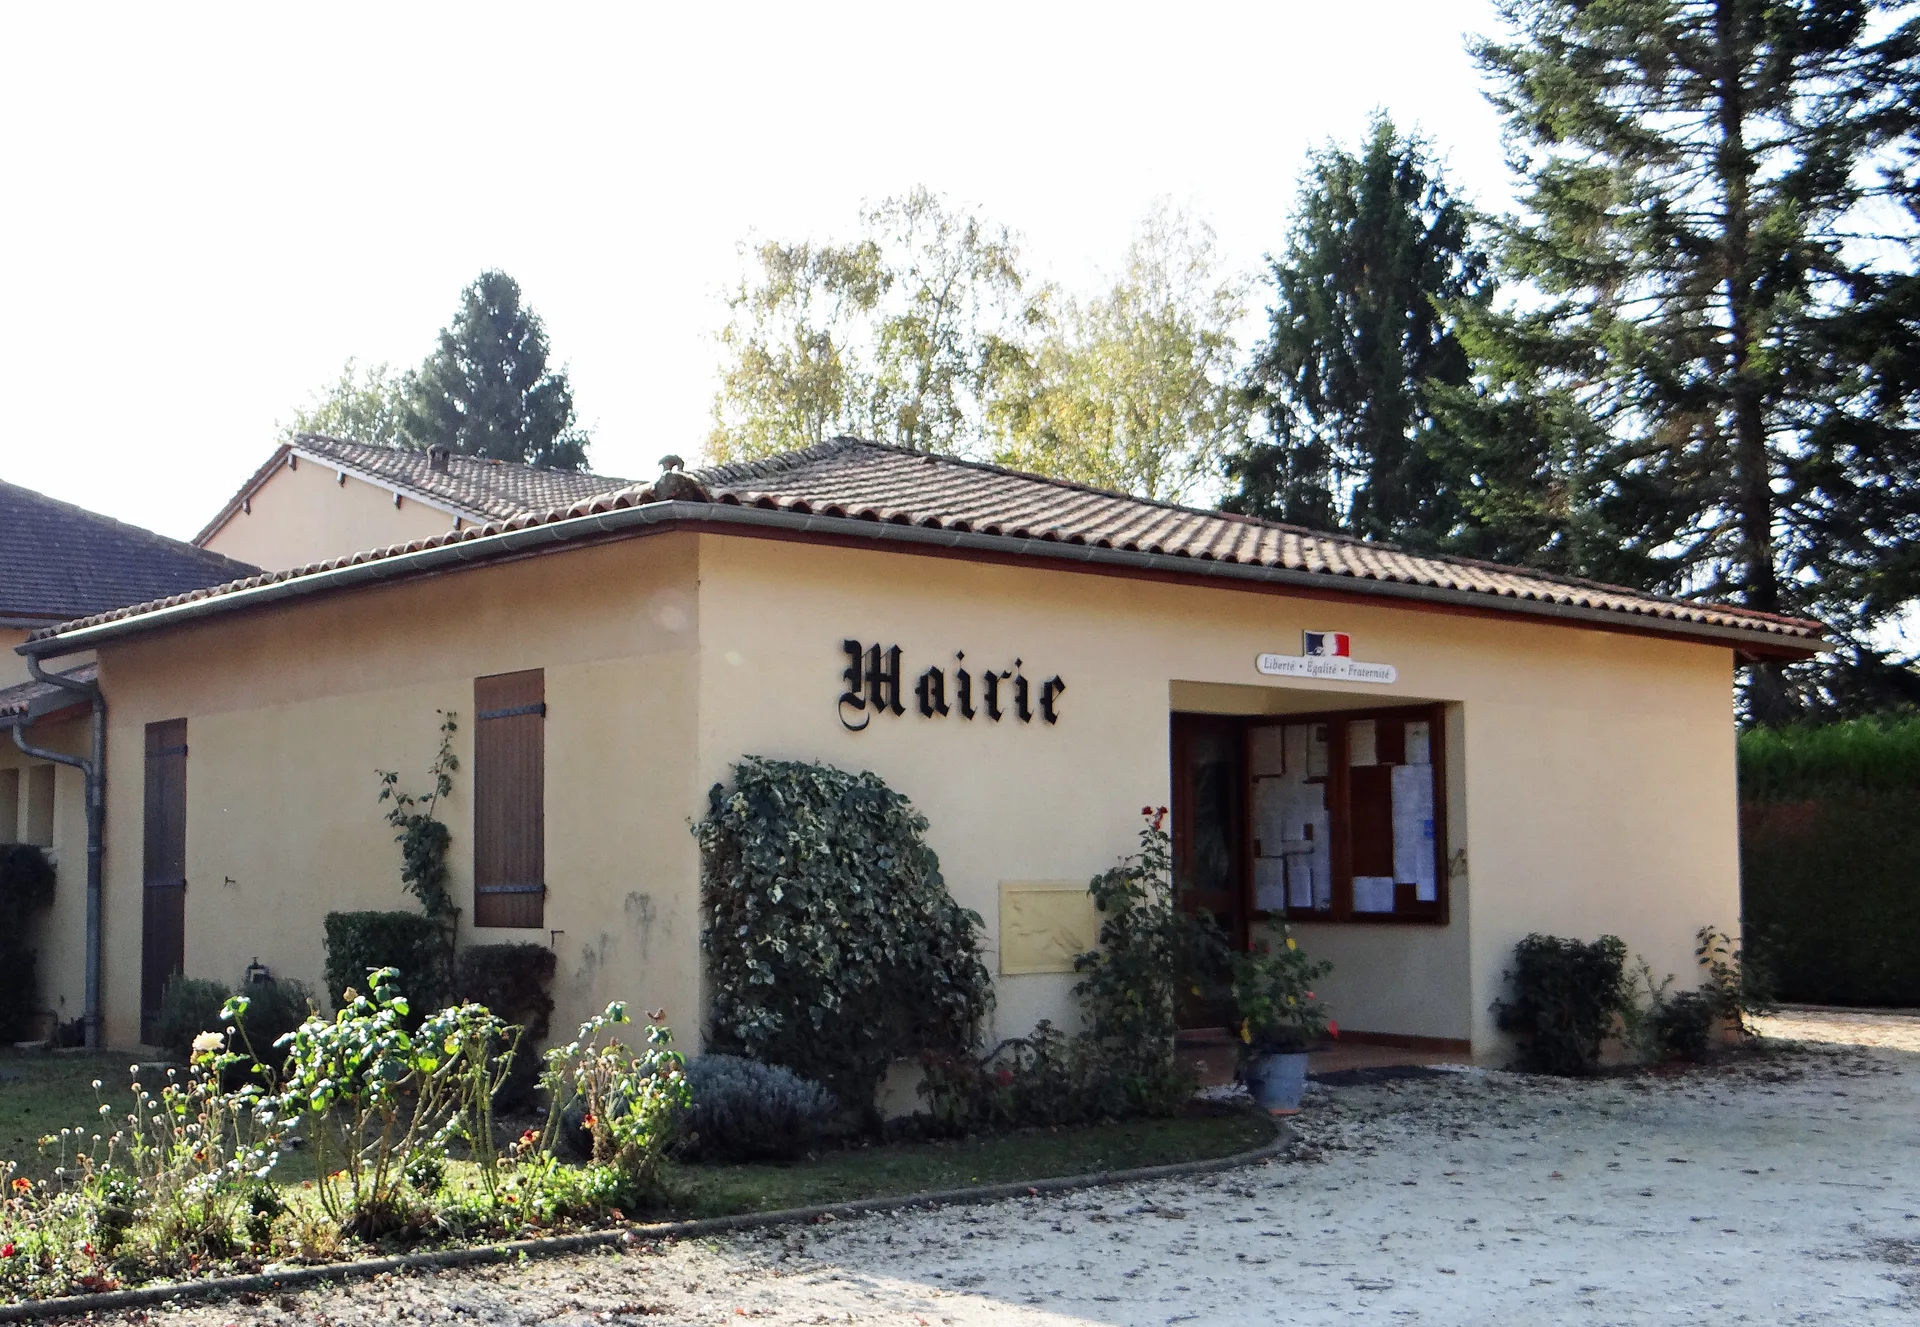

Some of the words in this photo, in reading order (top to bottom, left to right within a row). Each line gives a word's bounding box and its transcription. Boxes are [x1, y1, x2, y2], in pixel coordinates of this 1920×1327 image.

[838, 639, 1067, 732] Mairie
[1263, 657, 1296, 672] Liberté
[1306, 657, 1337, 676] Égalité
[1347, 664, 1390, 679] Fraternité
